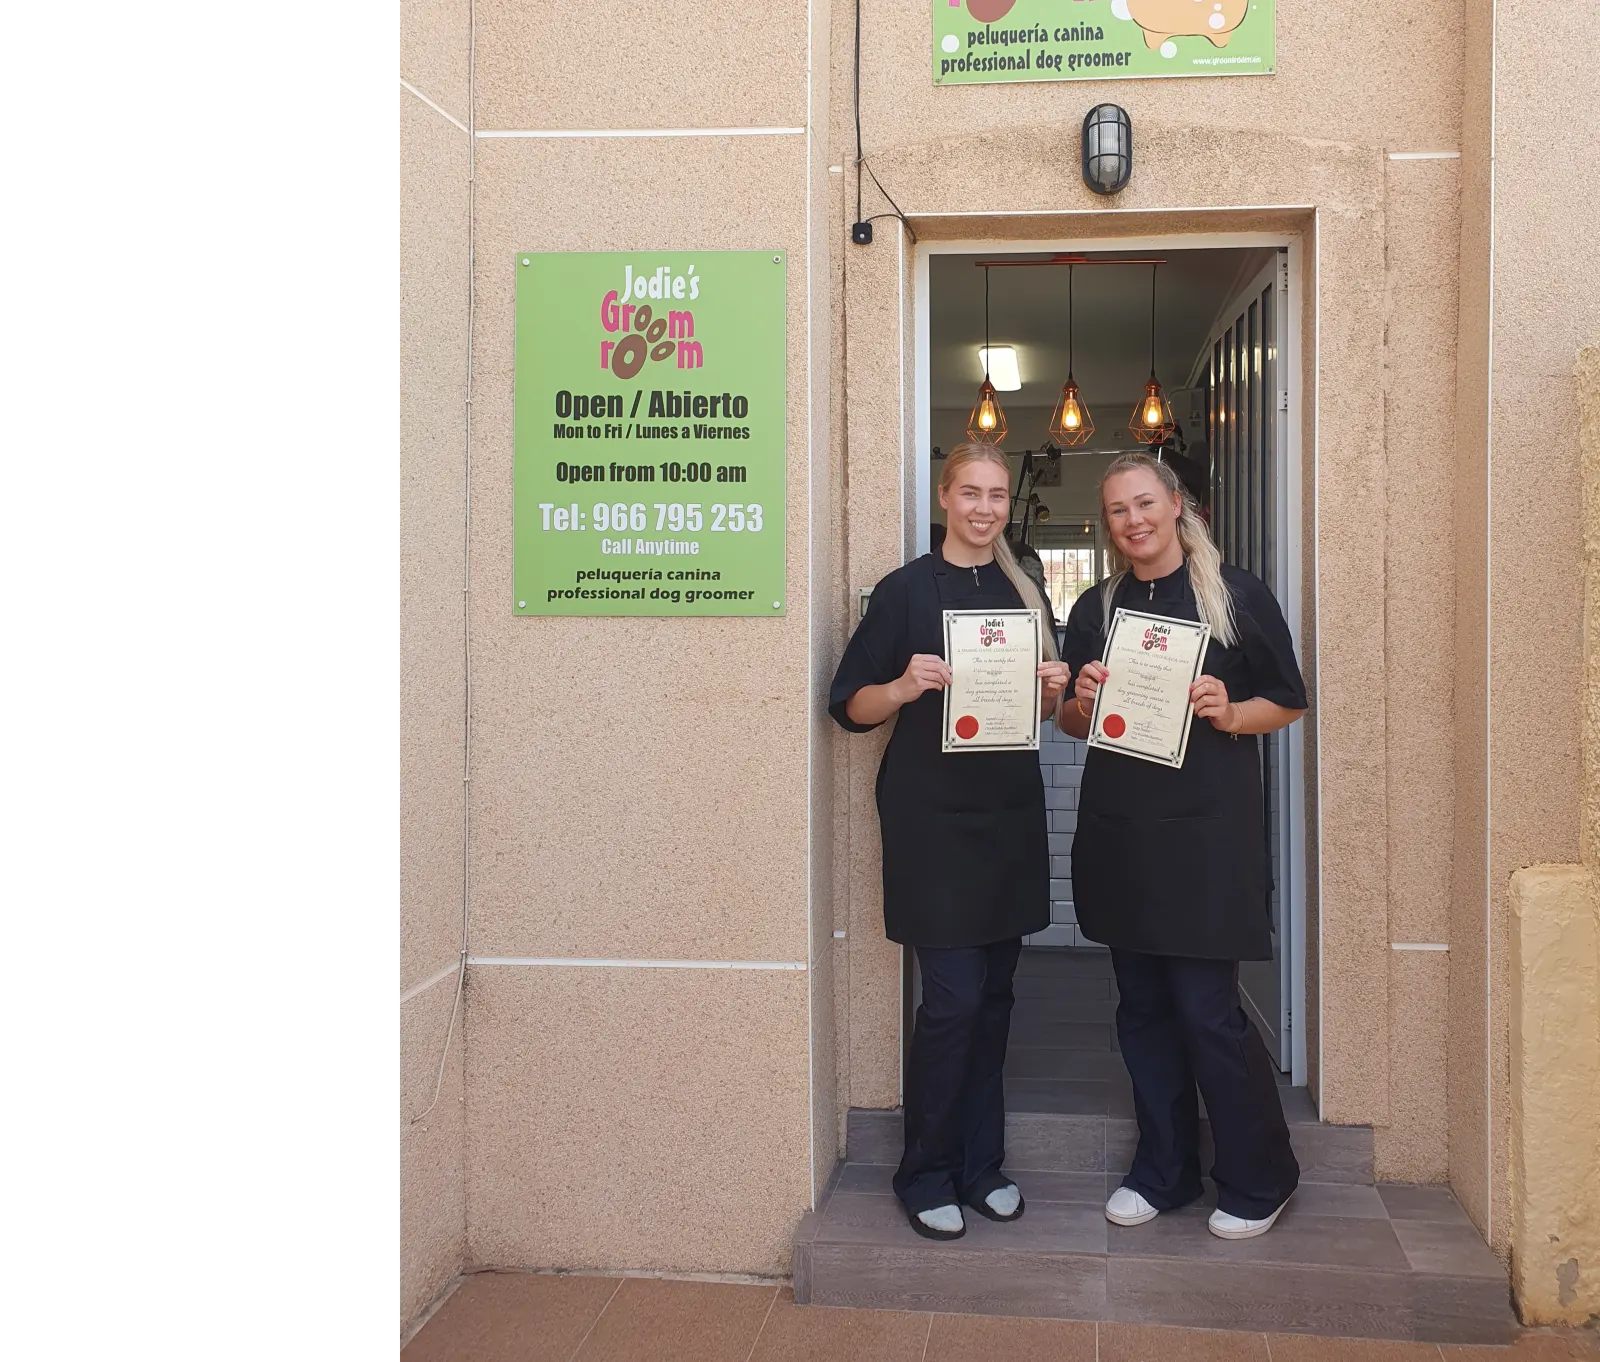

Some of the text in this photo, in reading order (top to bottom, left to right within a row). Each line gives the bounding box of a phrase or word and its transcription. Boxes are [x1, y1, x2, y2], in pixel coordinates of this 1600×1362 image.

[967, 21, 1104, 48] peluquería canina
[941, 48, 1132, 75] professional dog groomer
[620, 264, 700, 304] Jodie's
[601, 290, 695, 344] Groom
[555, 390, 624, 421] Open
[647, 390, 749, 419] Abierto
[553, 423, 584, 439] Mon
[587, 424, 602, 439] to
[604, 423, 623, 439] Fri
[635, 423, 679, 440] Lunes
[681, 427, 691, 440] a
[693, 423, 751, 440] Viernes
[556, 461, 747, 484] Open from 10:00 am
[538, 502, 764, 532] Tel: 966 795 253
[601, 538, 700, 556] Call Anytime
[576, 568, 721, 584] peluquería canina
[547, 587, 755, 603] professional dog groomer
[980, 624, 1004, 638] Groom
[985, 618, 1005, 629] Jodie's
[1151, 623, 1172, 635] Jodie's
[1144, 628, 1168, 644] Groom
